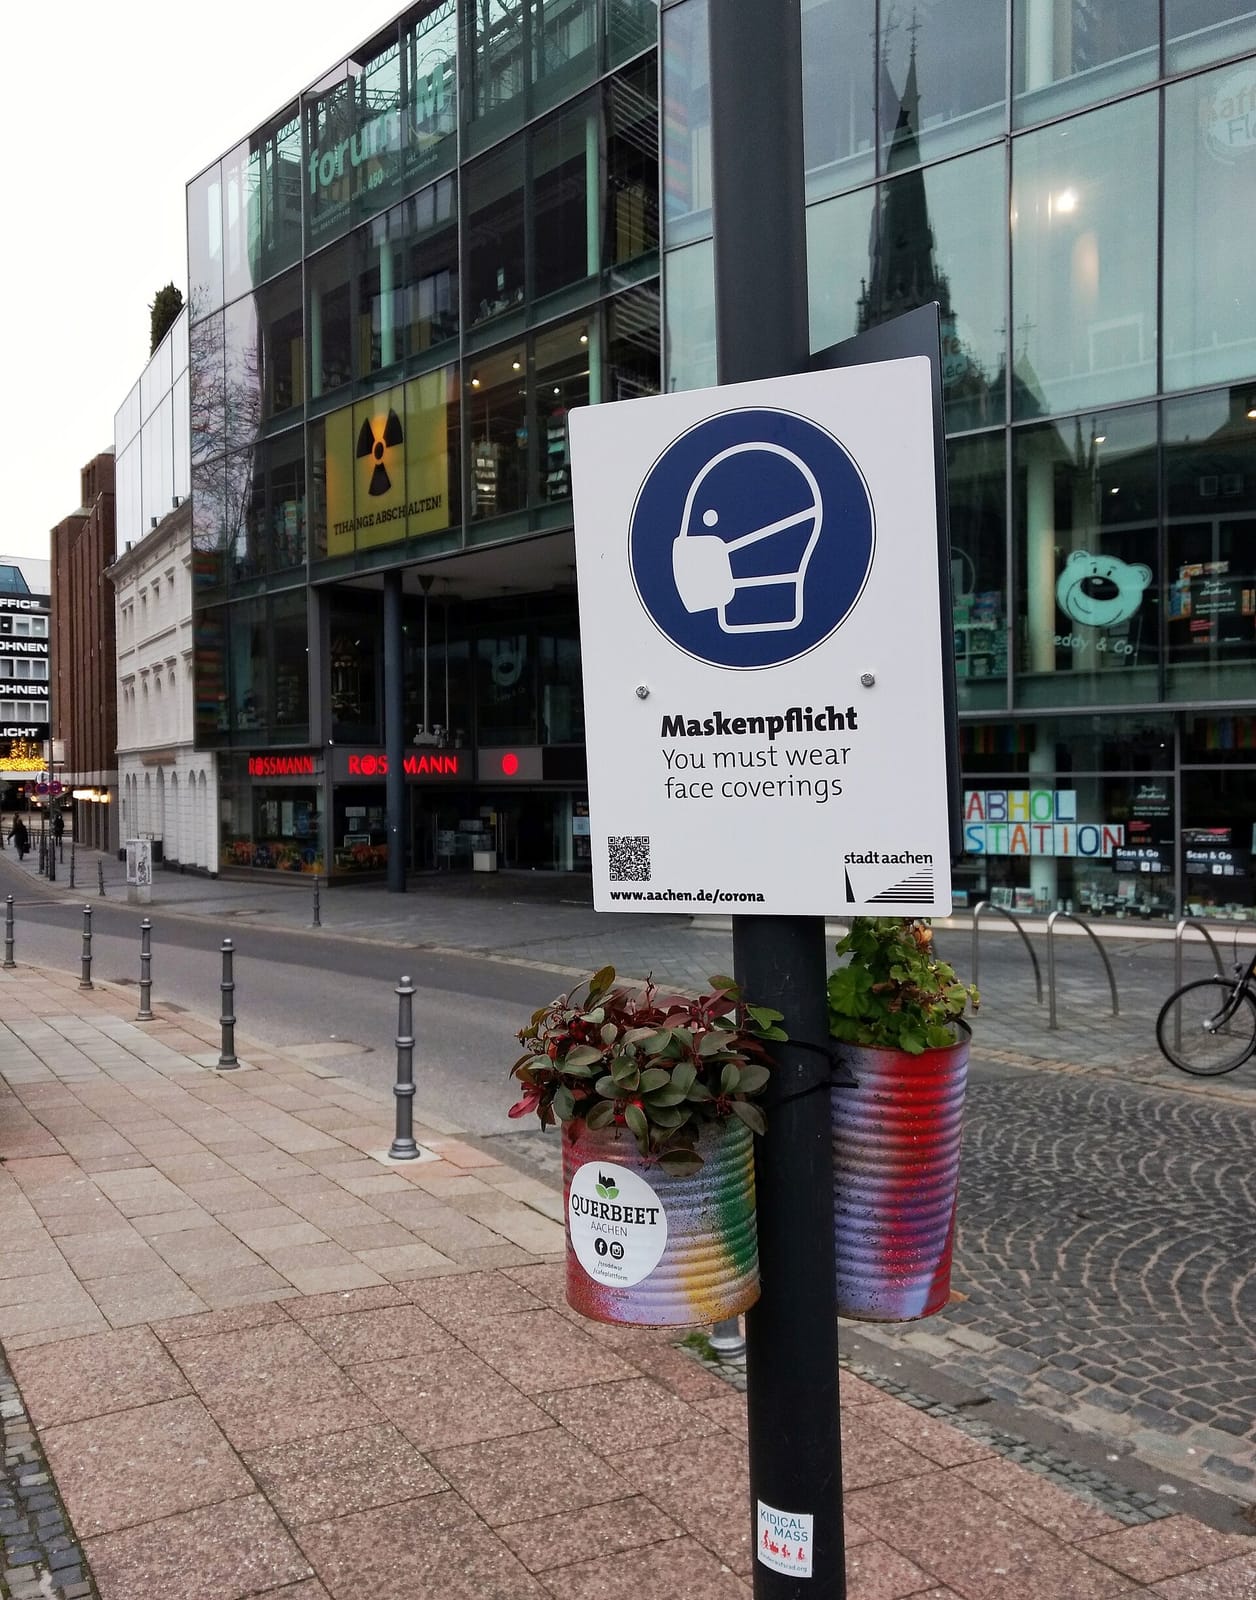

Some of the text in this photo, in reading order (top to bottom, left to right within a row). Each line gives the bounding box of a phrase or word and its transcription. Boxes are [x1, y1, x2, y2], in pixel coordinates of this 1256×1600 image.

[308, 105, 398, 194] forum
[333, 494, 442, 536] TIHANGE ABSCHALTEN!
[1053, 632, 1089, 655] eddy
[660, 705, 858, 741] Maskenpflicht
[249, 756, 314, 776] ROSSMANN
[348, 754, 458, 776] ROSMANN
[662, 745, 851, 770] You must wear
[664, 774, 843, 804] face coverings
[966, 791, 1075, 822] ABHOL
[966, 823, 1123, 856] STATION
[1116, 848, 1159, 858] Scan & Go
[1186, 850, 1232, 861] Scan & Go
[609, 888, 765, 904] www.aachen.de/corona
[571, 1193, 660, 1226] QUERBEET
[590, 1221, 628, 1238] AACHEN
[760, 1509, 804, 1530] KIDICAL
[774, 1526, 809, 1543] MASS
